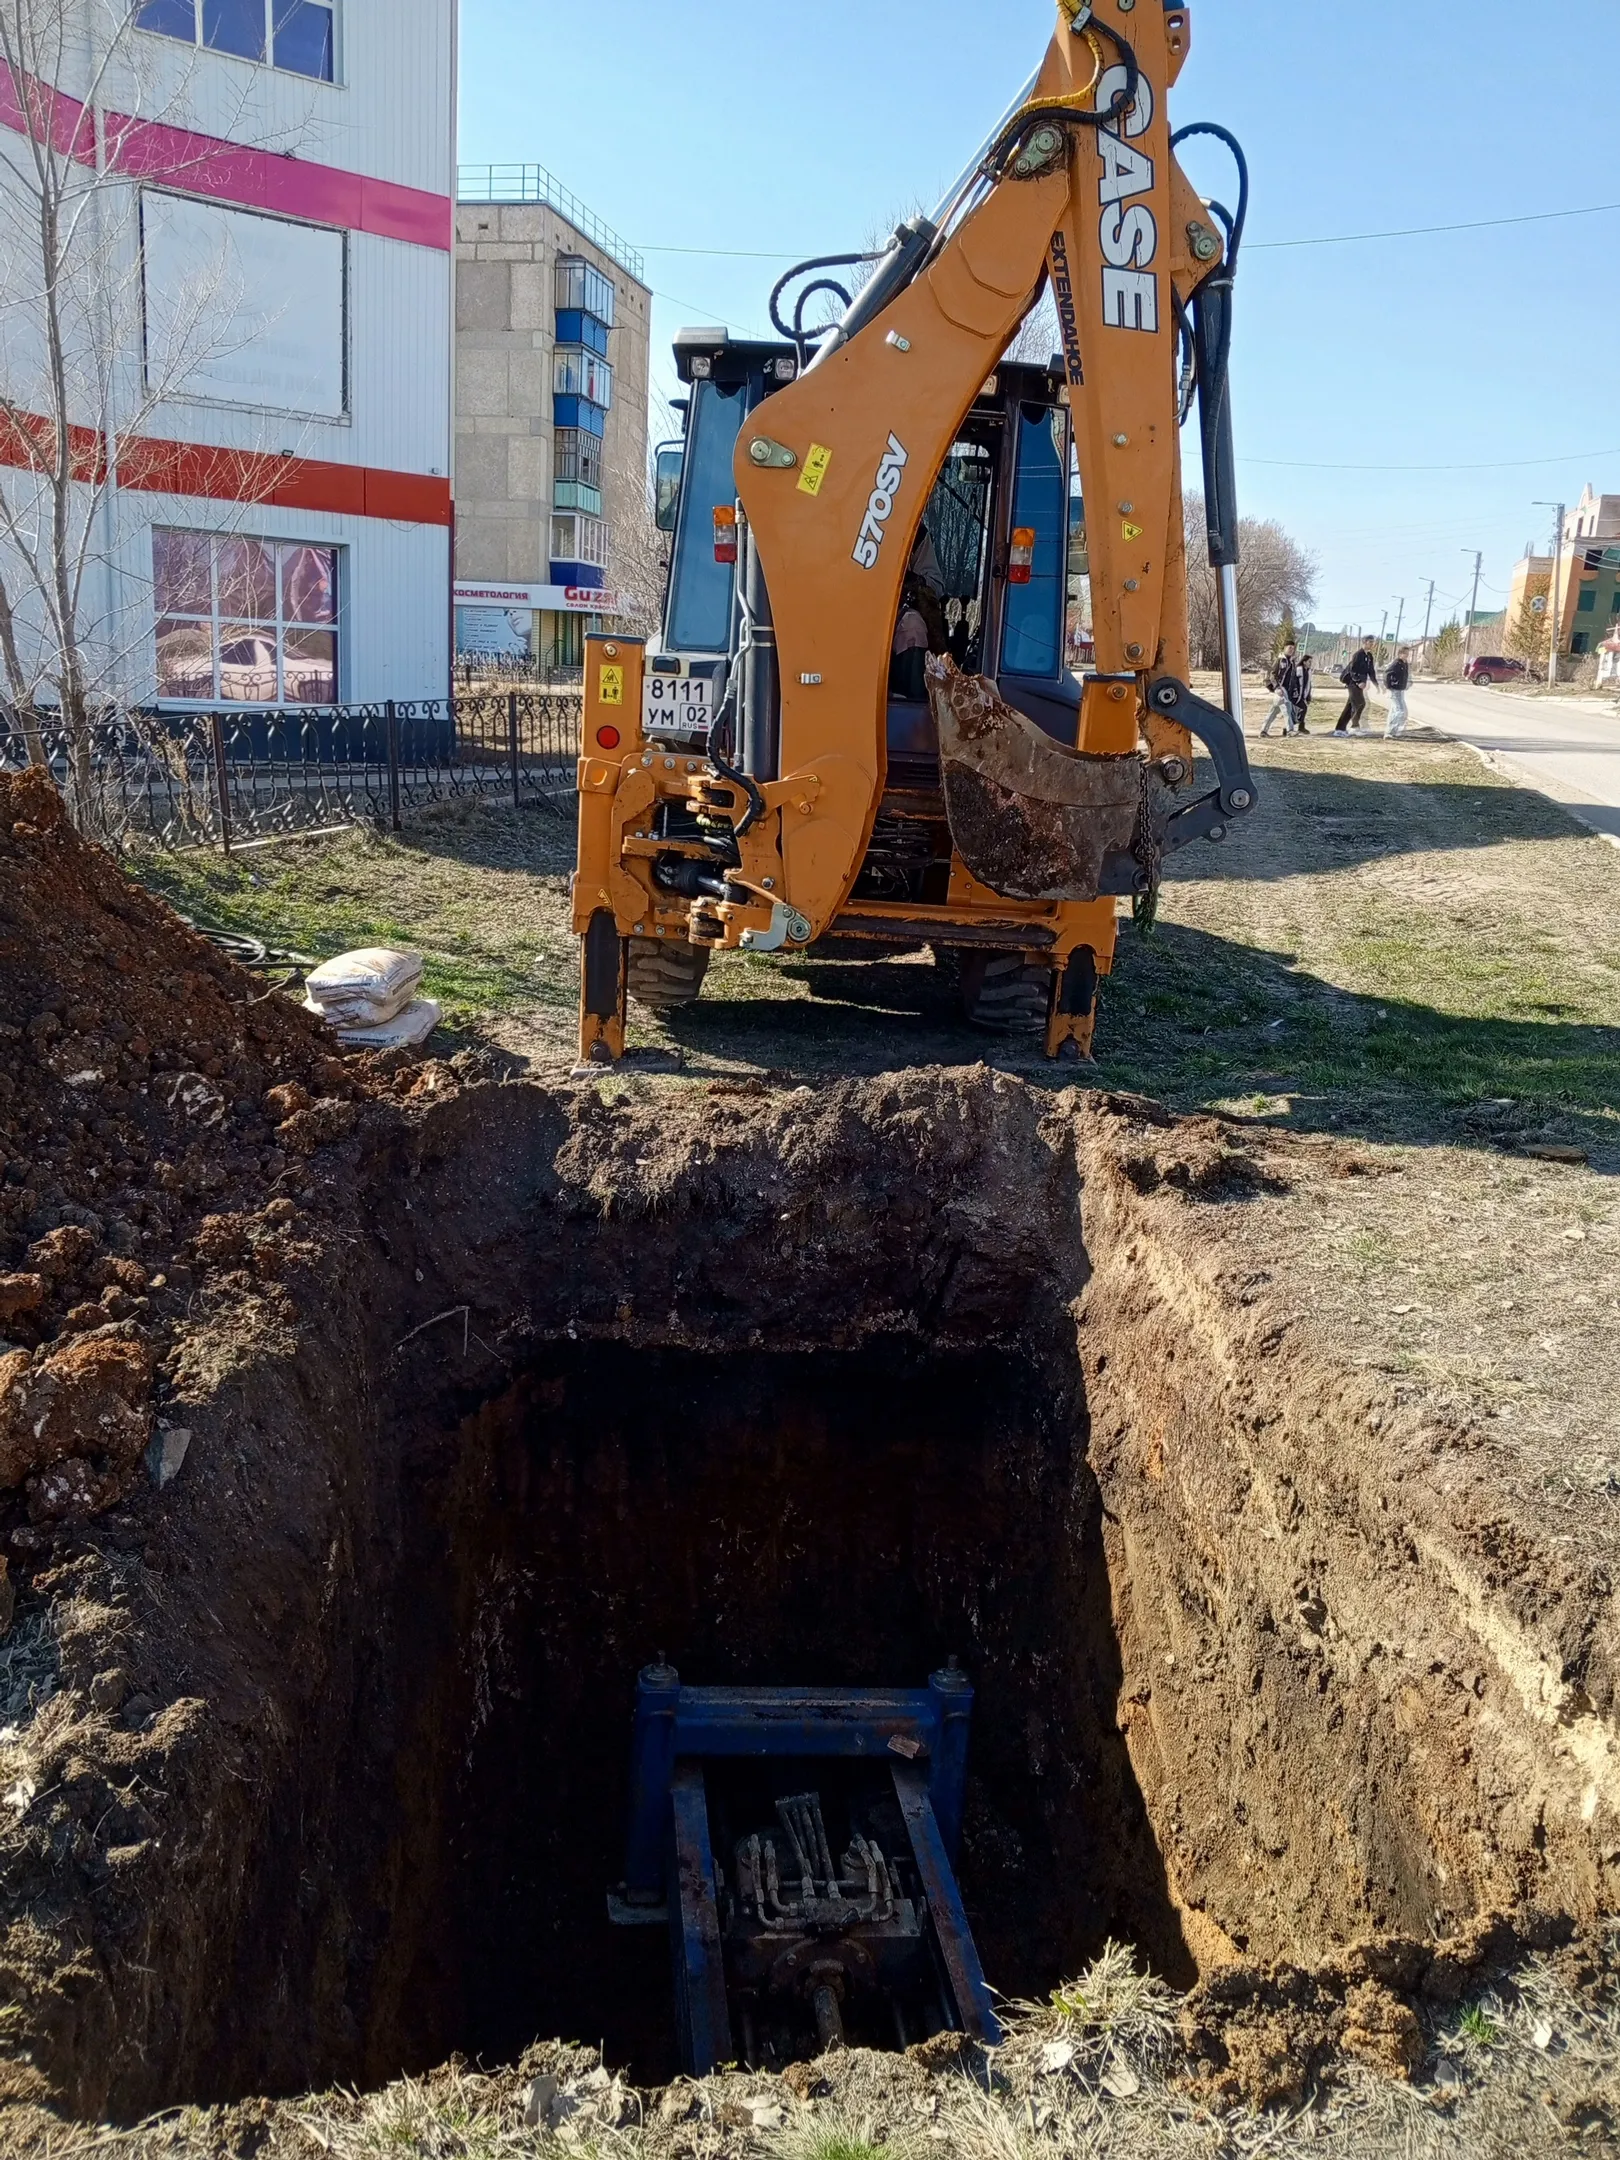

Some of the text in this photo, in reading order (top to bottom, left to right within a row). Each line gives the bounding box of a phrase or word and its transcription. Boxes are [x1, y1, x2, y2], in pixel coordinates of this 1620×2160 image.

[1095, 63, 1158, 333] CASE
[1050, 230, 1085, 386] EXTENDAHOE
[851, 429, 909, 569] 570SV
[453, 588, 530, 601] КОСМЕТОЛОГИЯ
[651, 678, 704, 702] 8111
[682, 722, 698, 730] RUS
[686, 706, 707, 723] 02
